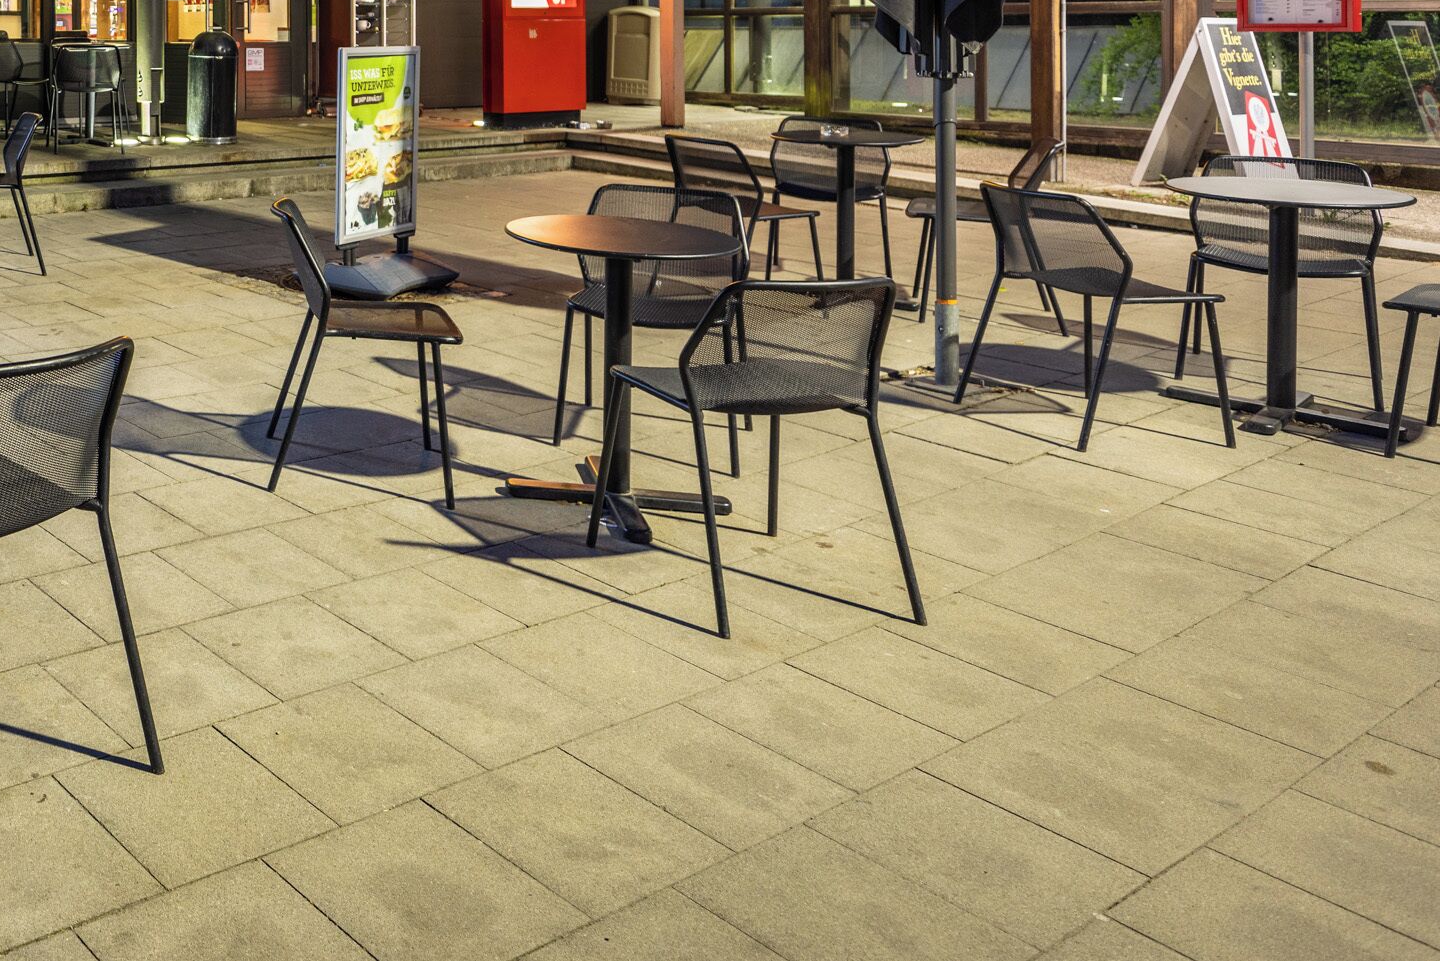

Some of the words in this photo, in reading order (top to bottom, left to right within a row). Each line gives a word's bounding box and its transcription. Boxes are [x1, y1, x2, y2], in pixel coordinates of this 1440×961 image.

[1219, 26, 1242, 45] Hier
[1219, 47, 1241, 67] gibt's
[1241, 47, 1255, 62] die
[350, 69, 362, 80] ISS
[363, 67, 381, 79] WAS
[1222, 67, 1262, 90] Vignette.
